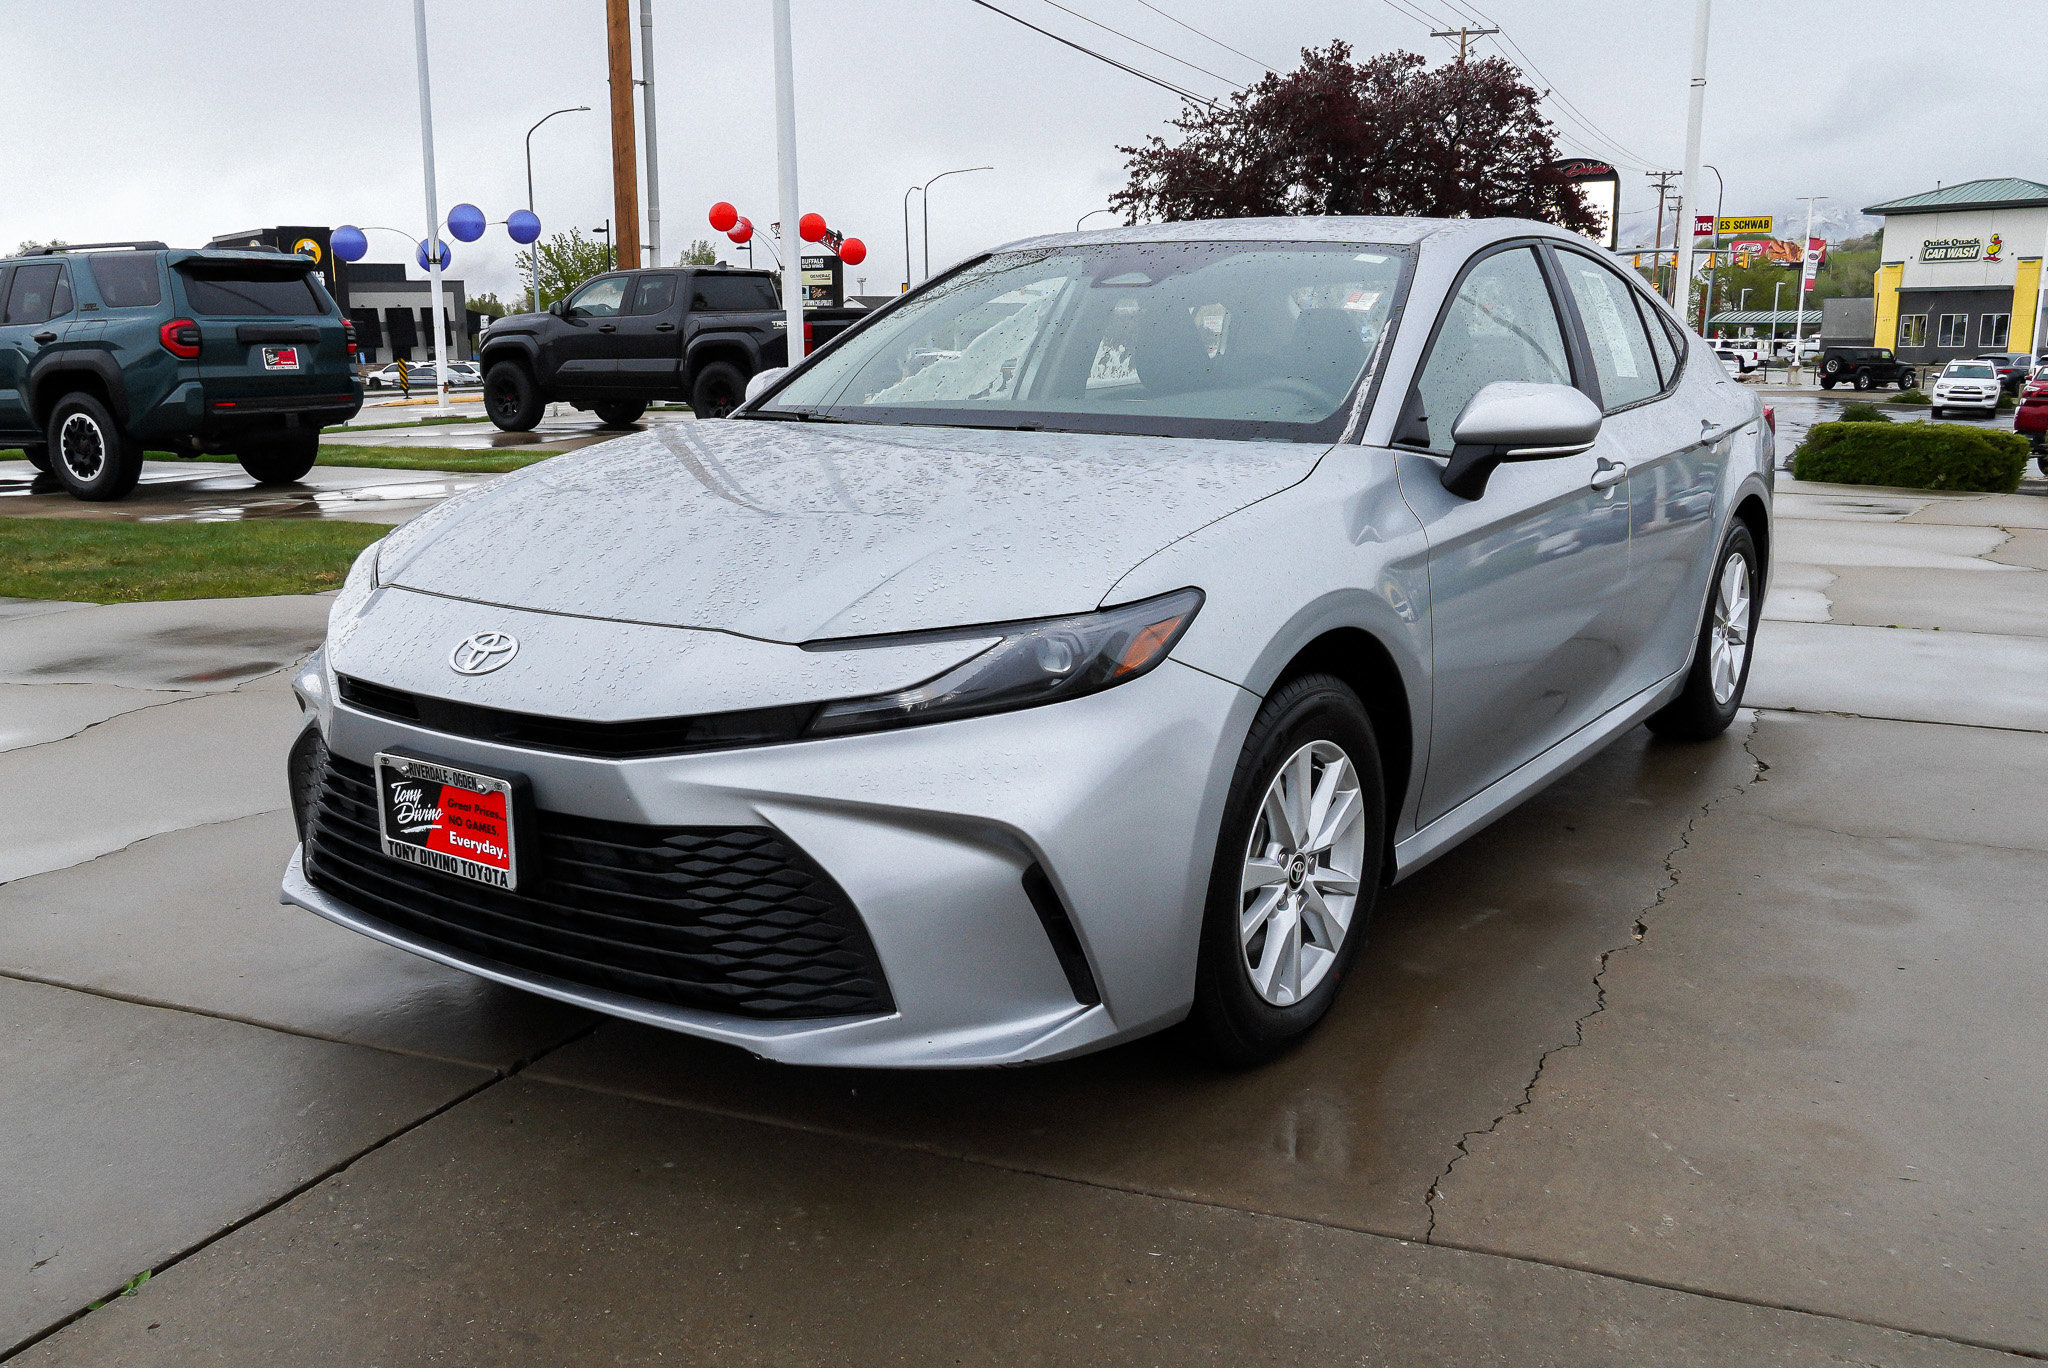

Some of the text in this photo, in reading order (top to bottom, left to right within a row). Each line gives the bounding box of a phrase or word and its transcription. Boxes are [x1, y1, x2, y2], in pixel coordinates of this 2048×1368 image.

[1695, 218, 1713, 231] ires
[1734, 220, 1769, 230] SCHWAB
[1925, 246, 1979, 259] CAR WASH
[1951, 238, 1980, 246] Quack
[408, 762, 448, 784] RIVERDALE
[452, 772, 478, 791] OGDEN
[391, 781, 422, 807] Tony
[393, 802, 444, 824] Divino
[447, 798, 472, 813] Great
[448, 815, 500, 837] NO GAMES.
[449, 831, 507, 860] Everyday.
[388, 841, 509, 888] TONY DIVINO TOYOTA
